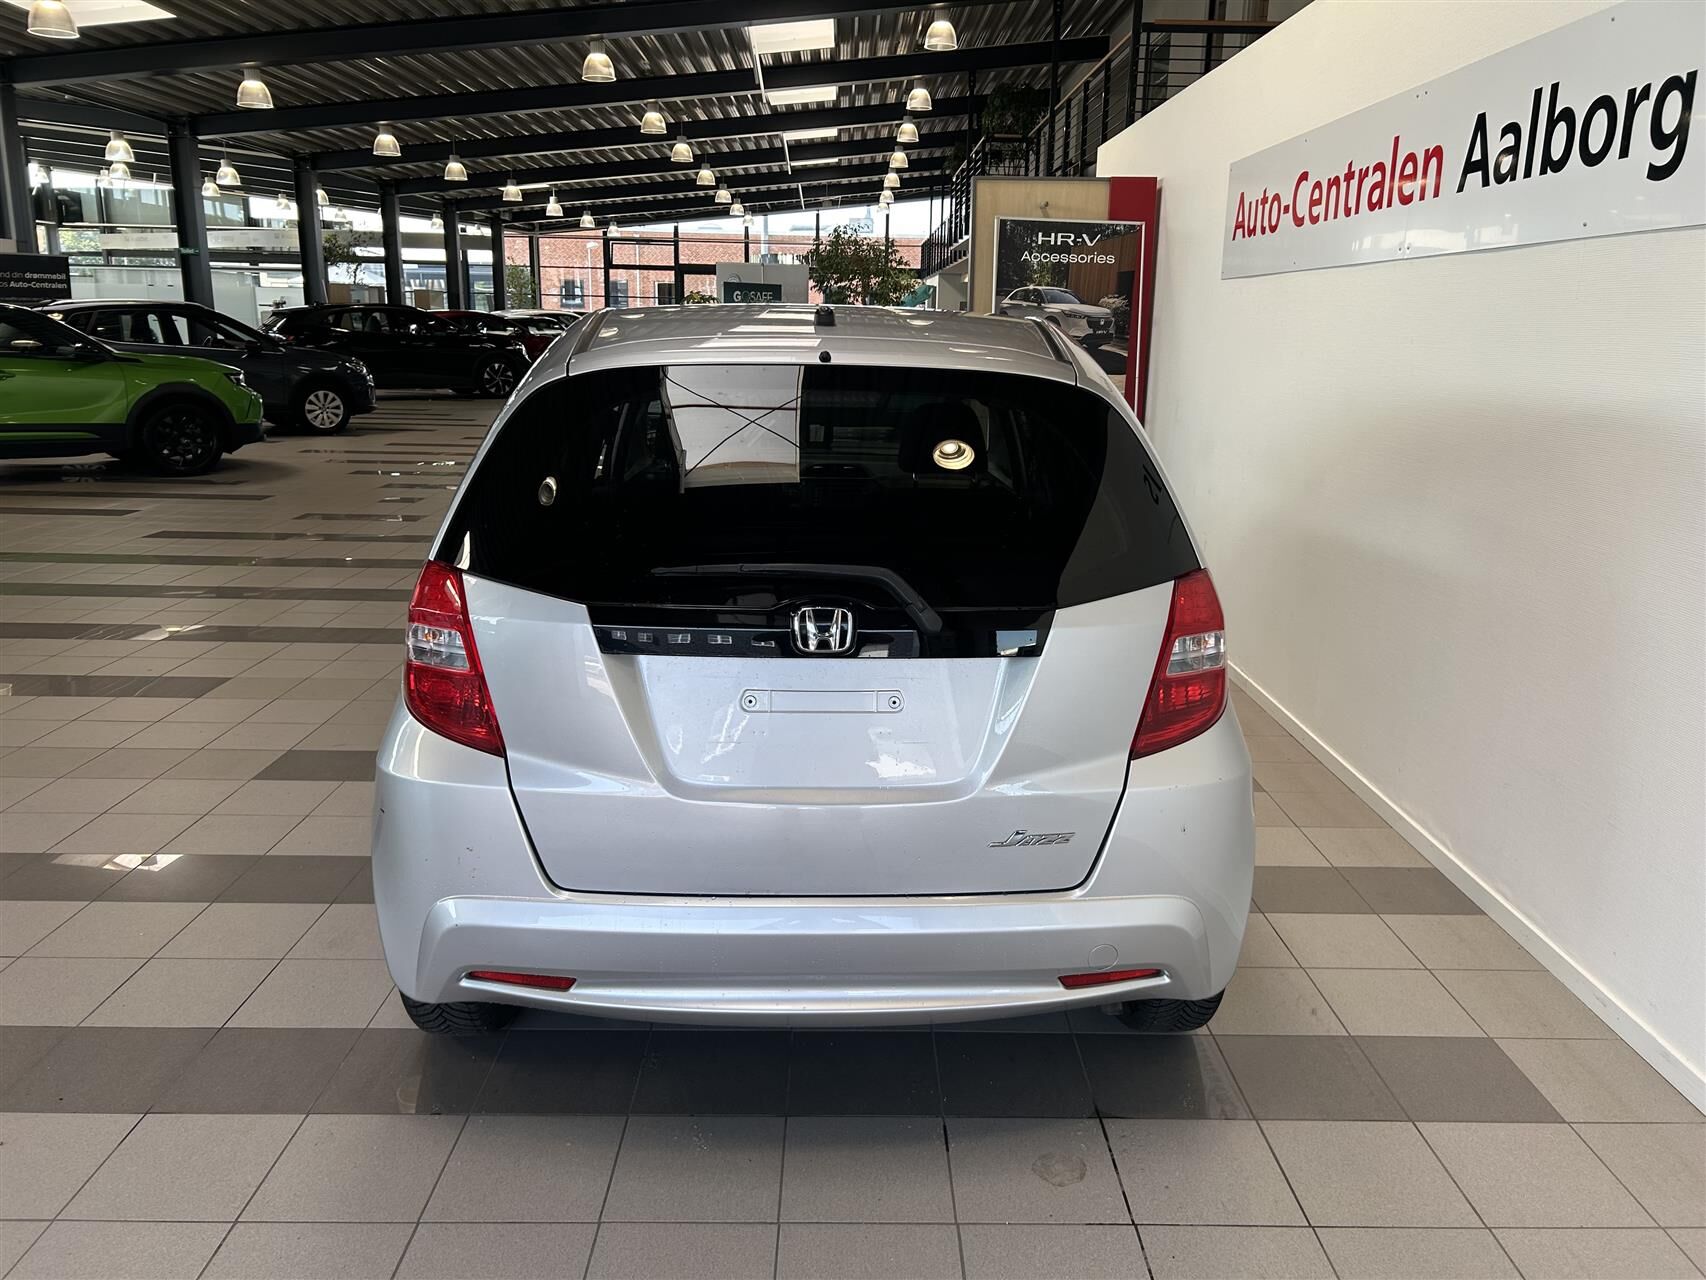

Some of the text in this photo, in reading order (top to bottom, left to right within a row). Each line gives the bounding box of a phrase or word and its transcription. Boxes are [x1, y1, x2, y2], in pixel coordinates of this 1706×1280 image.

[1232, 69, 1698, 241] Auto-Centralen Aalborg
[1037, 232, 1102, 247] HR-V
[1020, 251, 1116, 264] Accessories
[9, 280, 67, 289] Auto-Centralen
